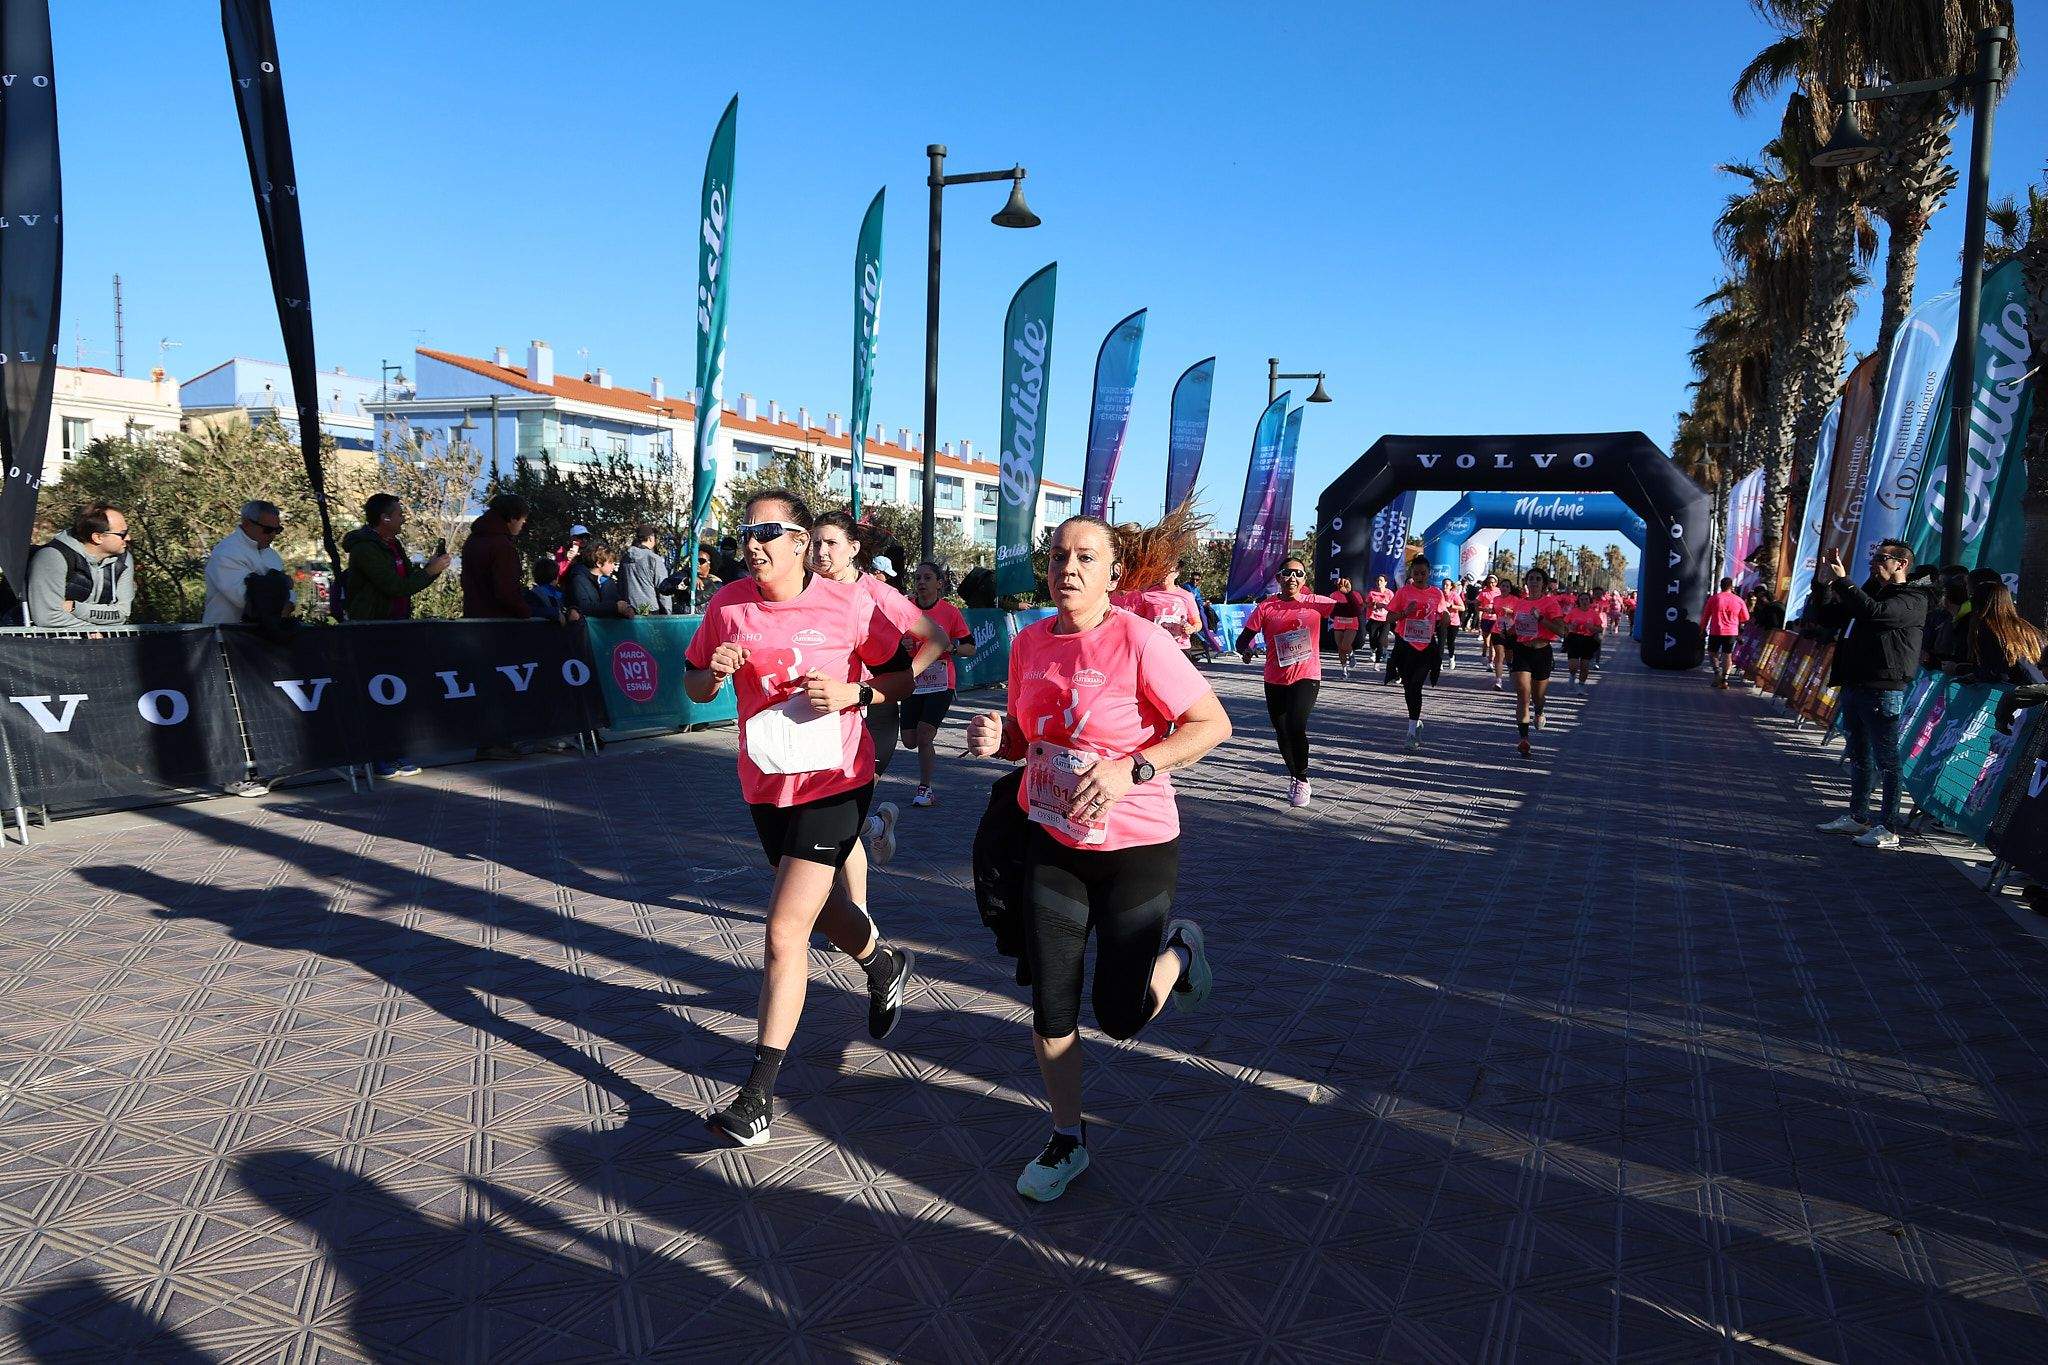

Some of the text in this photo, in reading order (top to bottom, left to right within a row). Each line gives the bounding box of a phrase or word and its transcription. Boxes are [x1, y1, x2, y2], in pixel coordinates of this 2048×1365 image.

[1000, 318, 1048, 512] Batiste
[1909, 370, 1937, 463] Odontológicos
[1893, 400, 1915, 461] Institutos
[1417, 452, 1594, 469] VOLVO
[1845, 434, 1864, 489] Institutos
[1513, 496, 1585, 525] Marlene
[1664, 523, 1684, 651] VOLVO
[89, 609, 120, 621] PUMA
[730, 632, 762, 642] OYSHO
[620, 651, 645, 659] MARCA
[273, 658, 591, 712] VOLVO
[626, 681, 652, 692] ESPAÑA
[1053, 784, 1070, 801] 01
[1037, 811, 1061, 825] OYSHO
